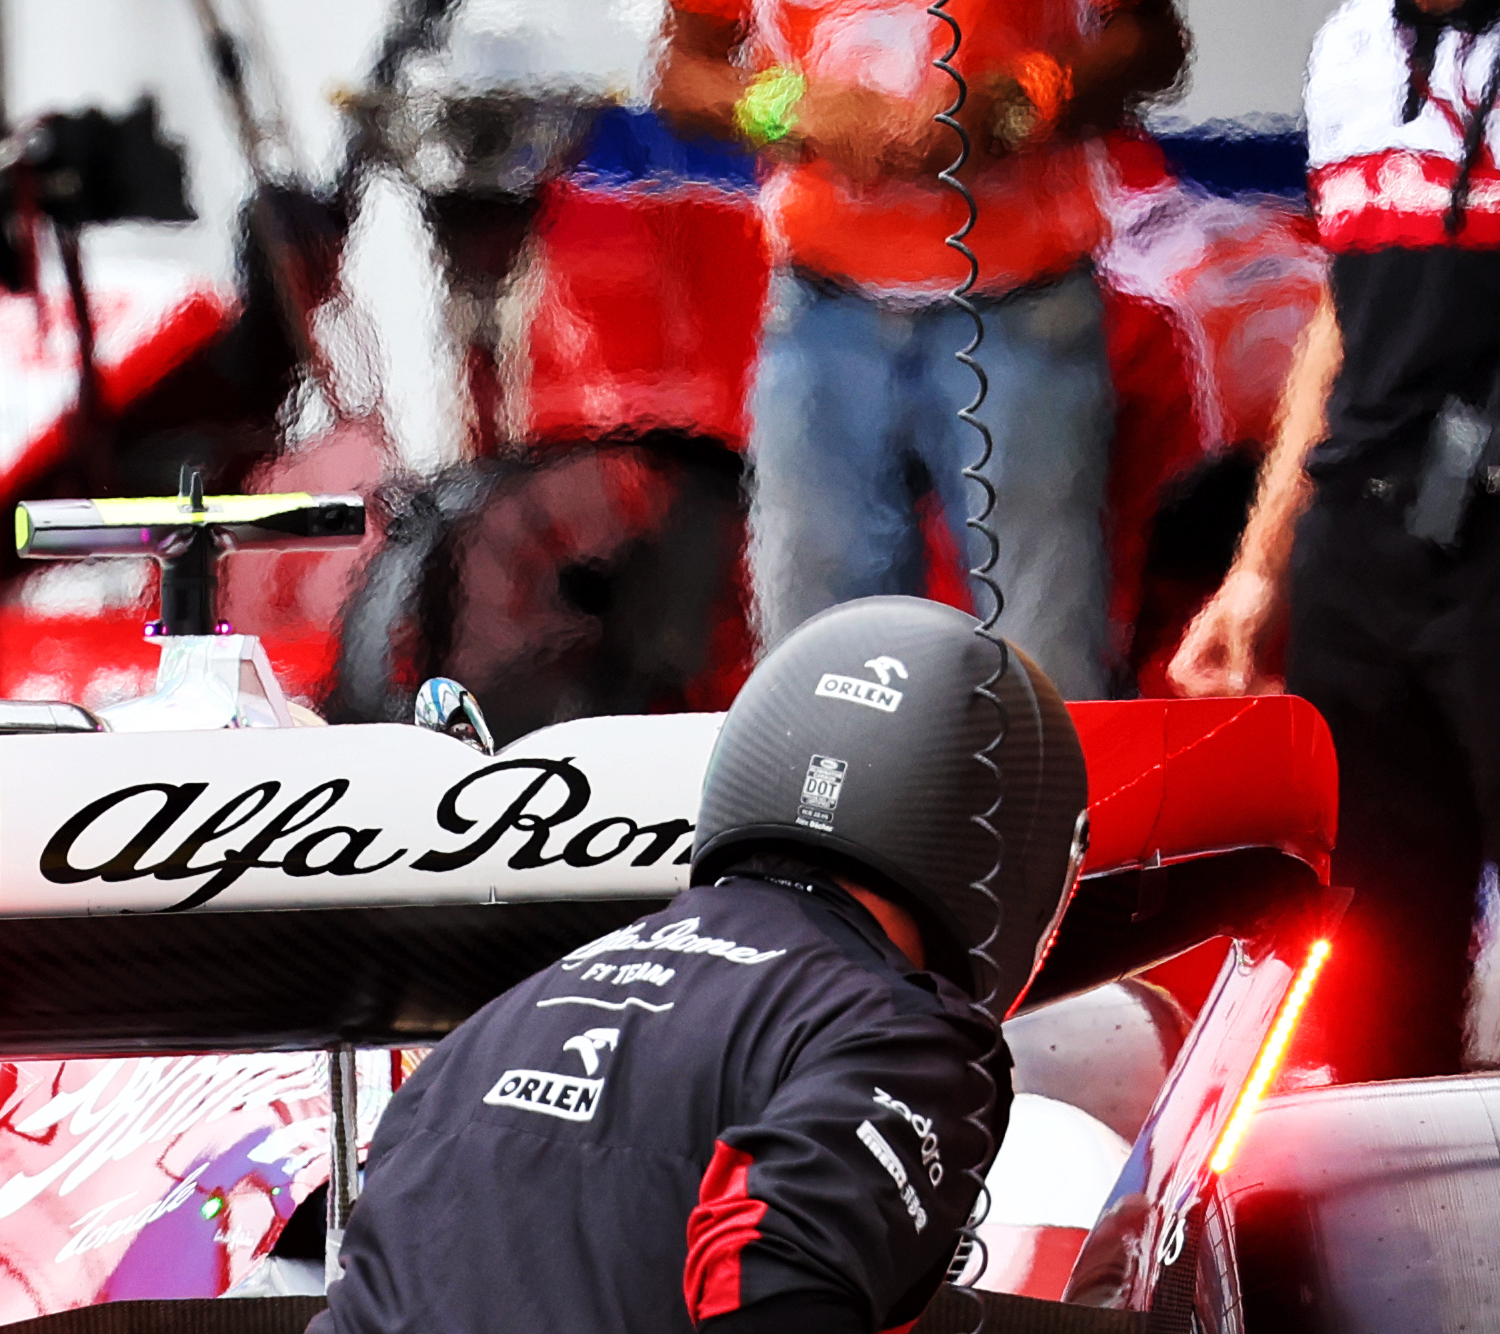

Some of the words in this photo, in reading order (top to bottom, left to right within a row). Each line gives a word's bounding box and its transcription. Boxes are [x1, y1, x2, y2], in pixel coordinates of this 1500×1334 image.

[824, 679, 894, 707] ORLEN
[805, 778, 838, 797] DOT
[39, 781, 406, 914] Alfa
[611, 961, 676, 987] TEAM
[498, 1076, 598, 1113] ORLEN
